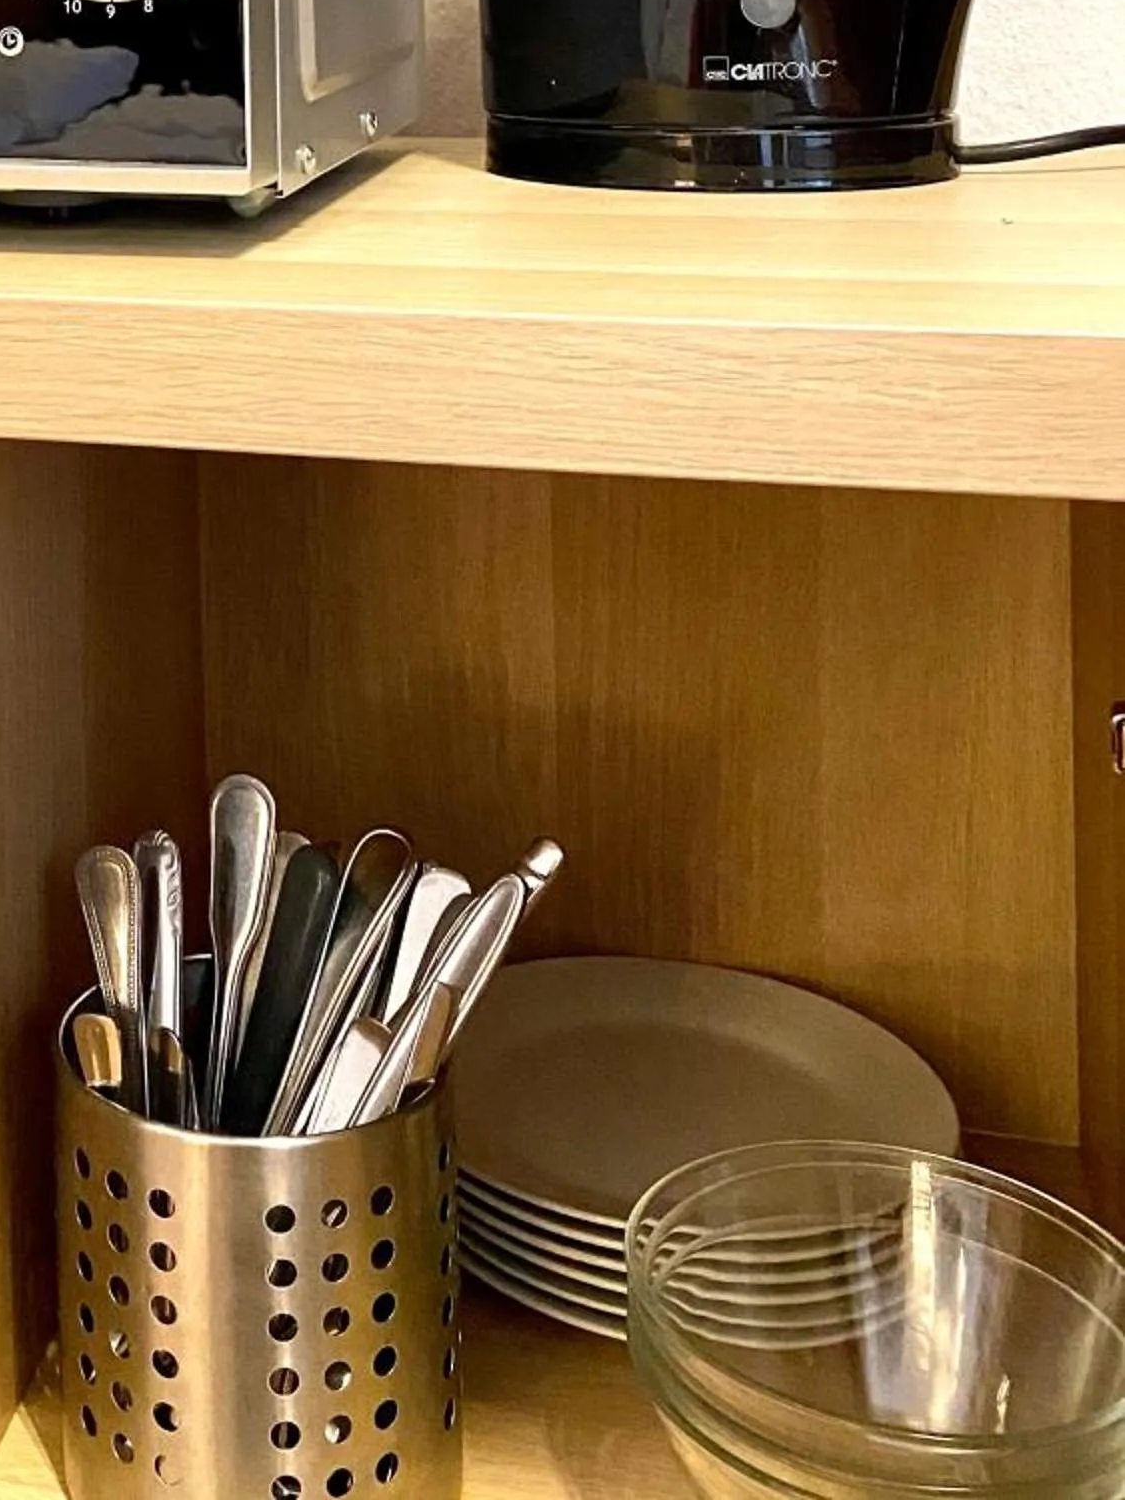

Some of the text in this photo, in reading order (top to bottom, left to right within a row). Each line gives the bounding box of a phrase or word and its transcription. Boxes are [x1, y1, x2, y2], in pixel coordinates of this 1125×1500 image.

[63, 0, 83, 14] 10
[105, 3, 116, 19] 9
[143, 0, 154, 14] 8
